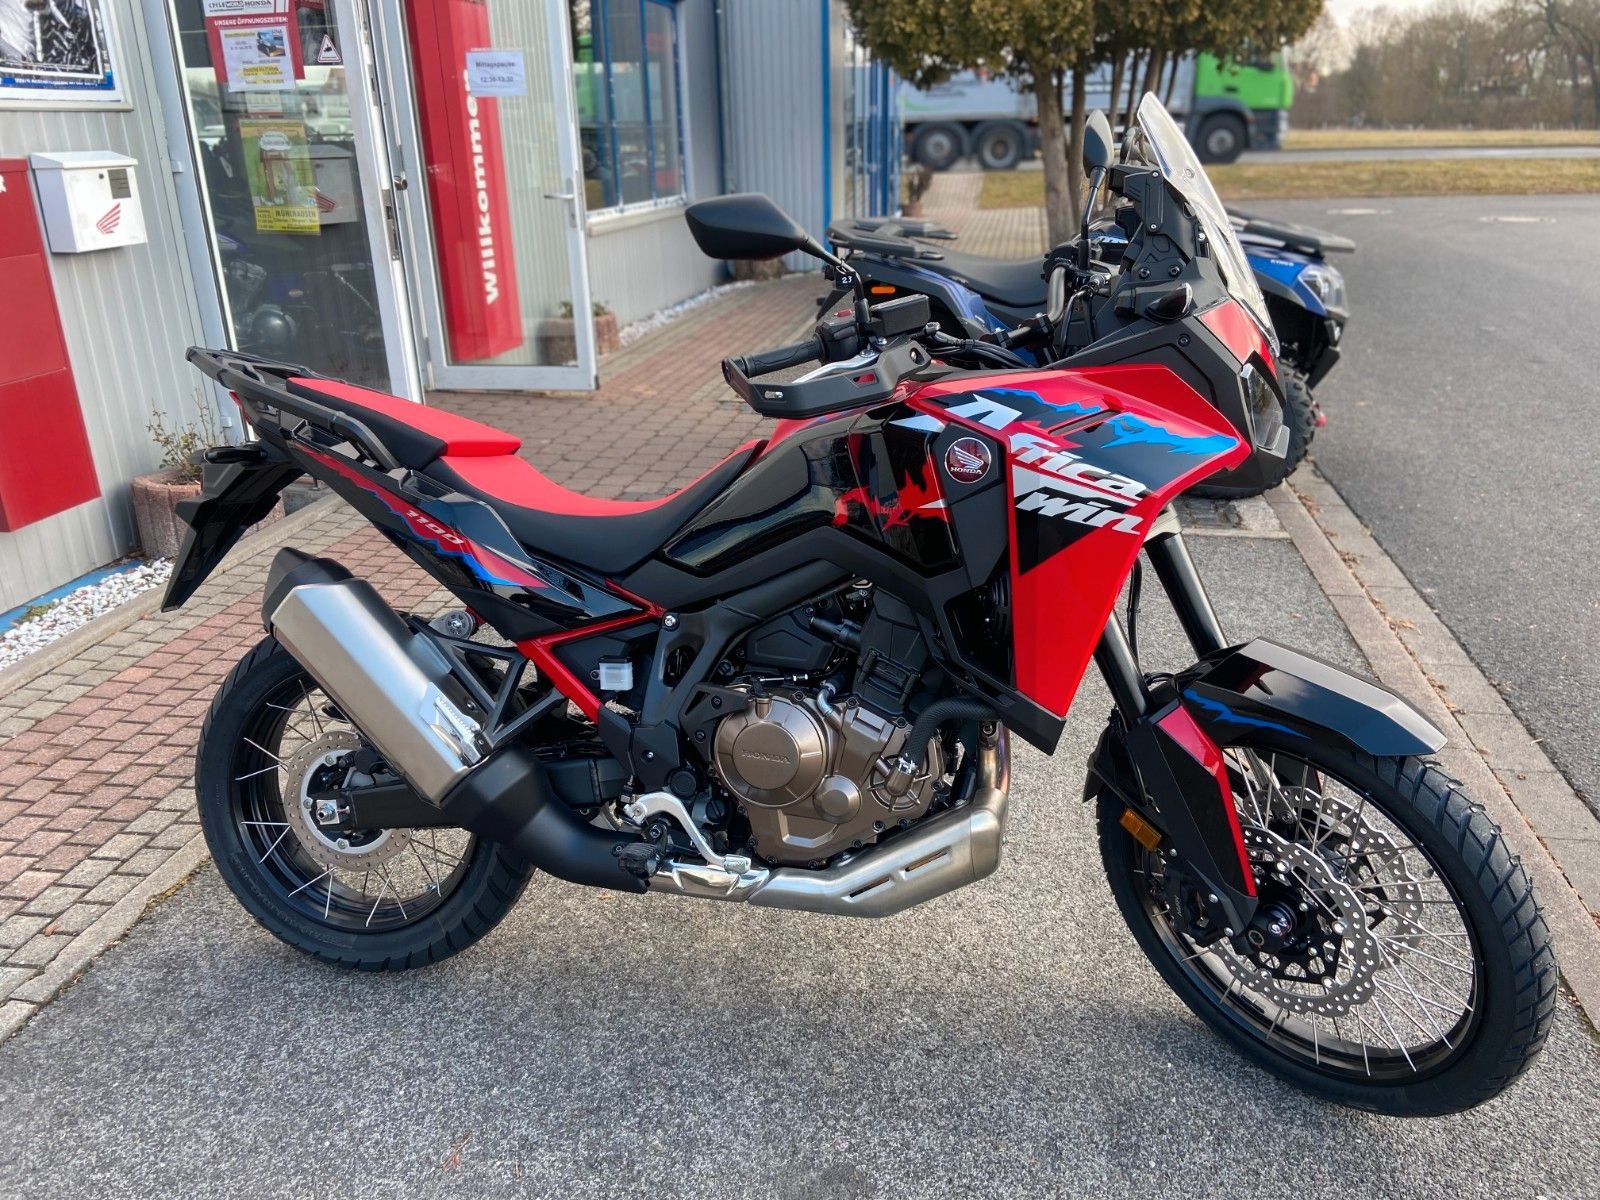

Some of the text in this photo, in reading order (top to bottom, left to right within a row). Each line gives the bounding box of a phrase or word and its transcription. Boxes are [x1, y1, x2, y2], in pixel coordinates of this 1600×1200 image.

[950, 466, 983, 475] HONDA
[405, 509, 465, 545] 1100
[741, 749, 792, 765] HONDA
